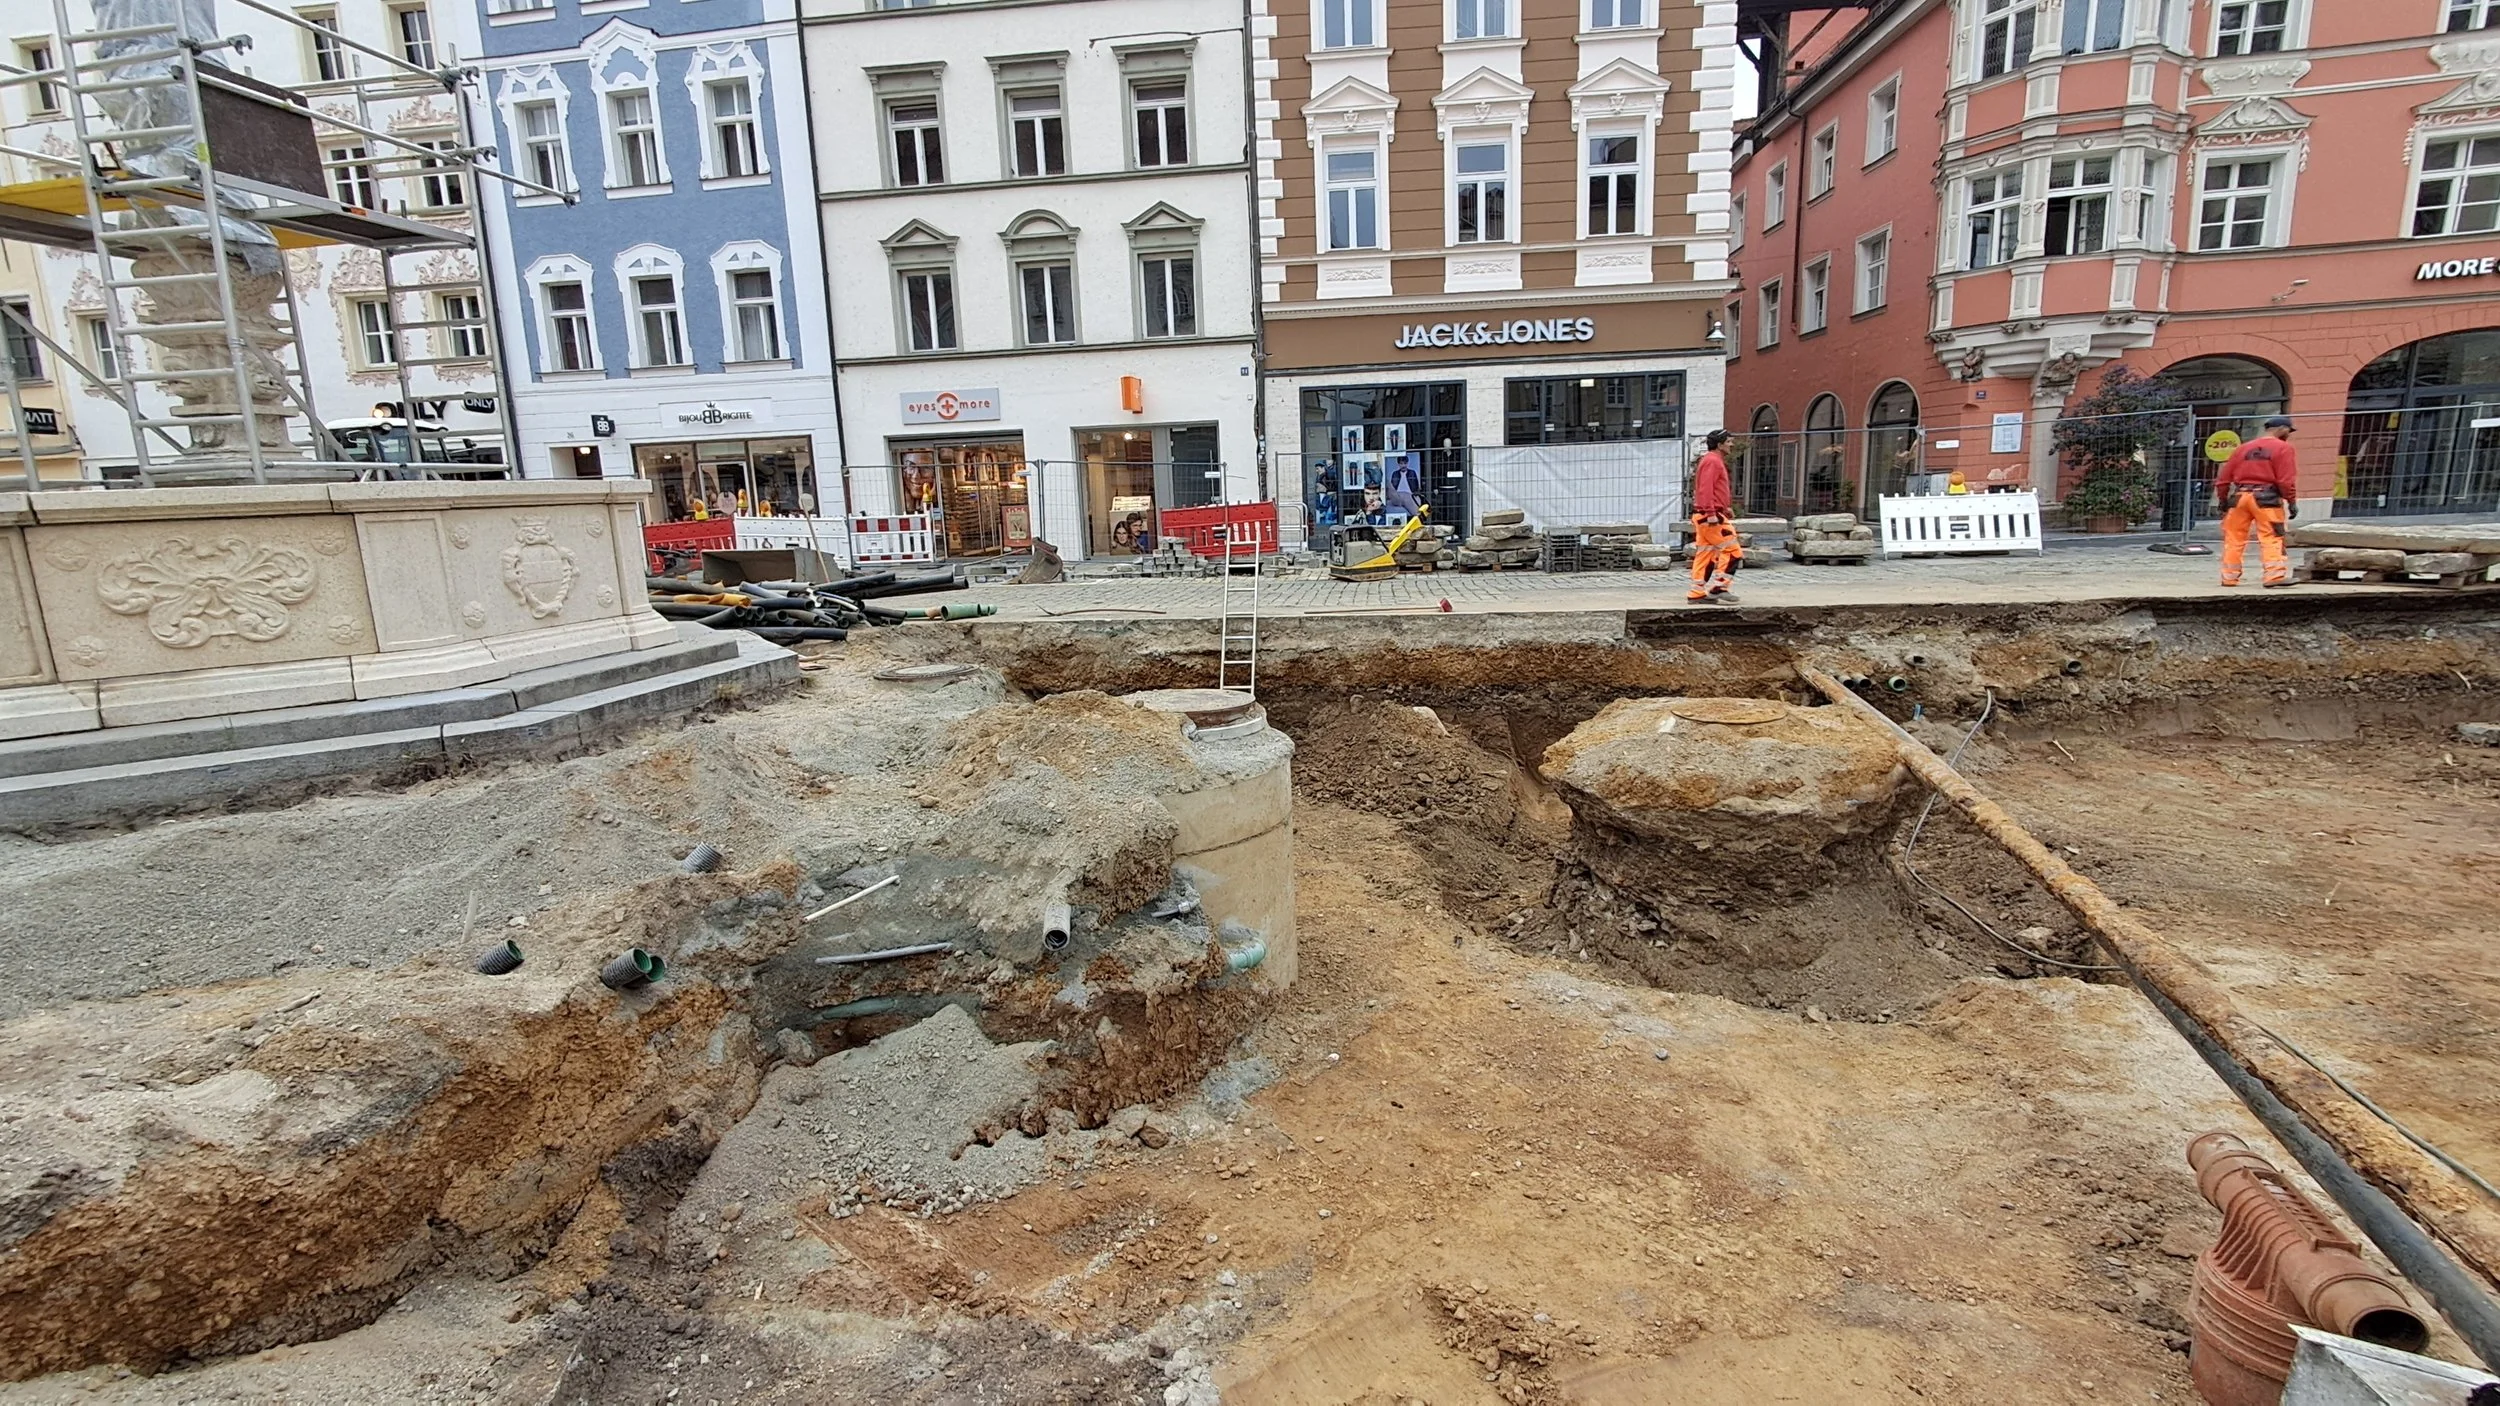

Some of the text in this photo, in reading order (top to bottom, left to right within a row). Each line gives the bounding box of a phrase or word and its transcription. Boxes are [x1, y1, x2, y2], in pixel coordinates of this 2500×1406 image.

[2416, 257, 2496, 280] MORE
[1395, 317, 1594, 349] JACK&JONES
[465, 398, 493, 409] ONLY
[909, 402, 936, 414] eyes
[960, 400, 990, 410] more
[2208, 440, 2237, 449] -20%
